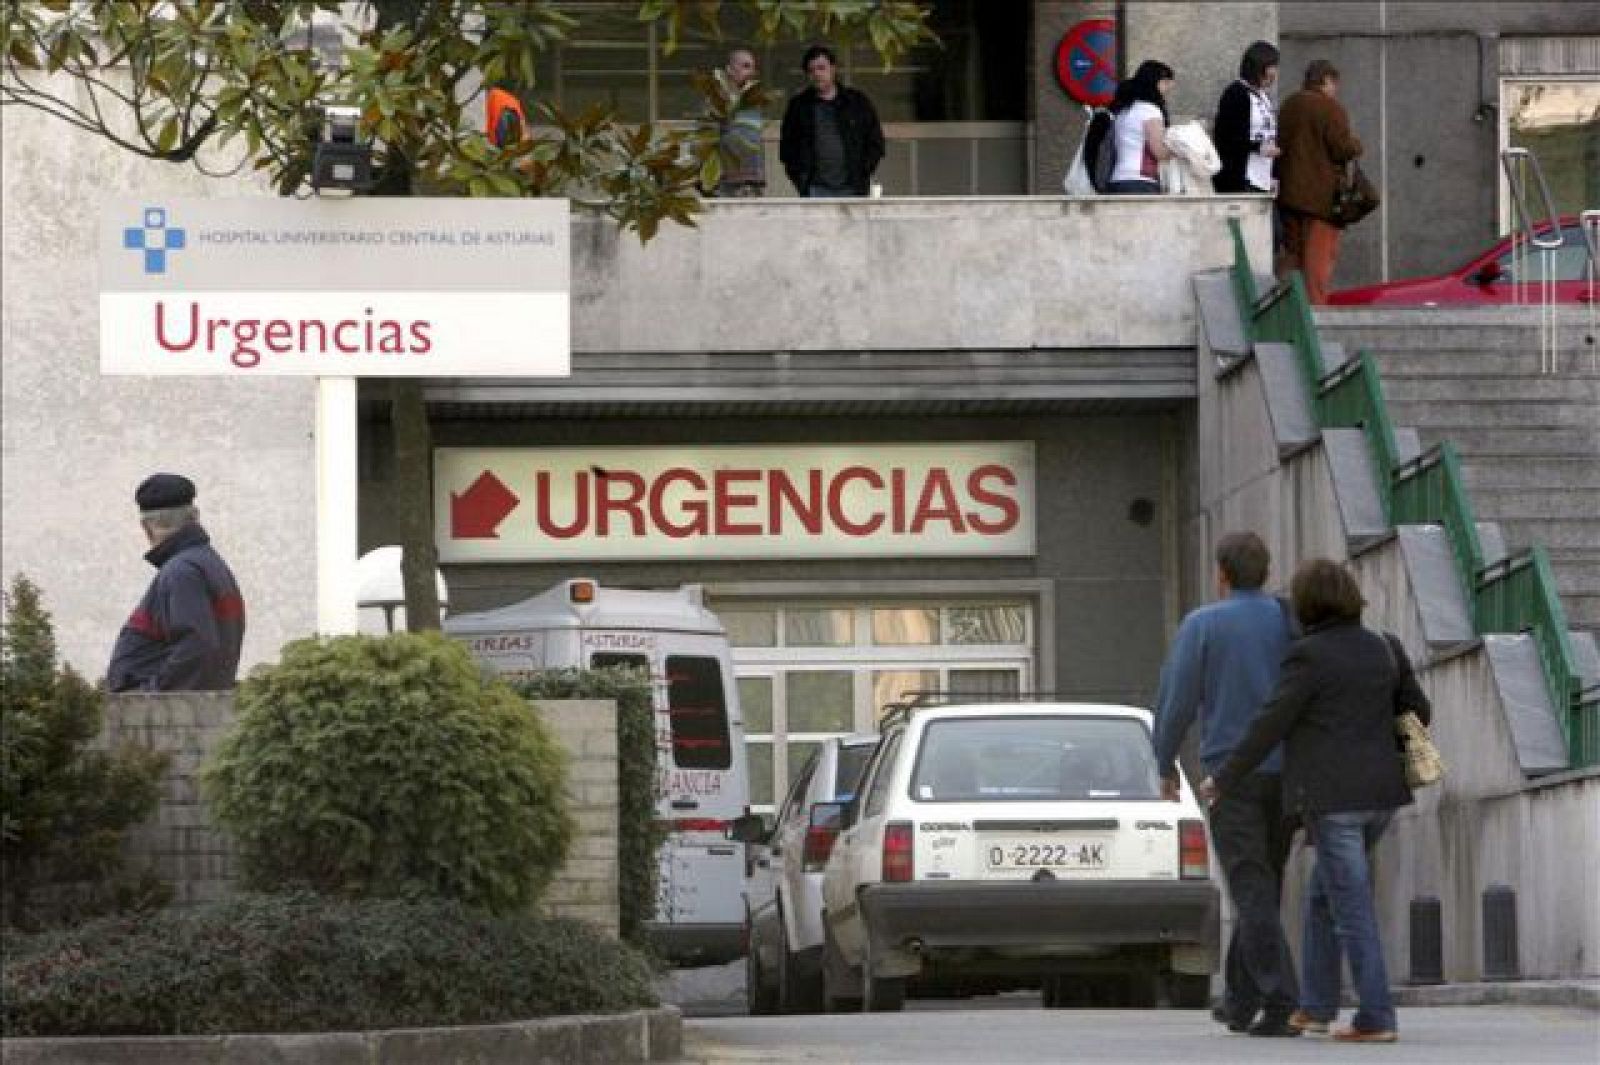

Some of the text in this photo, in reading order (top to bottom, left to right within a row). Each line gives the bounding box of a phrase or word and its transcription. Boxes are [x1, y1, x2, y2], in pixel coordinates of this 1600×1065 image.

[199, 230, 555, 246] HOSPITAL UNIVERSITARIO CENTRAL DE ASTURIAS
[154, 301, 433, 368] Urgencias
[535, 464, 1020, 538] URGENCIAS
[470, 635, 534, 652] URIAS
[583, 632, 657, 649] ASTURIAS
